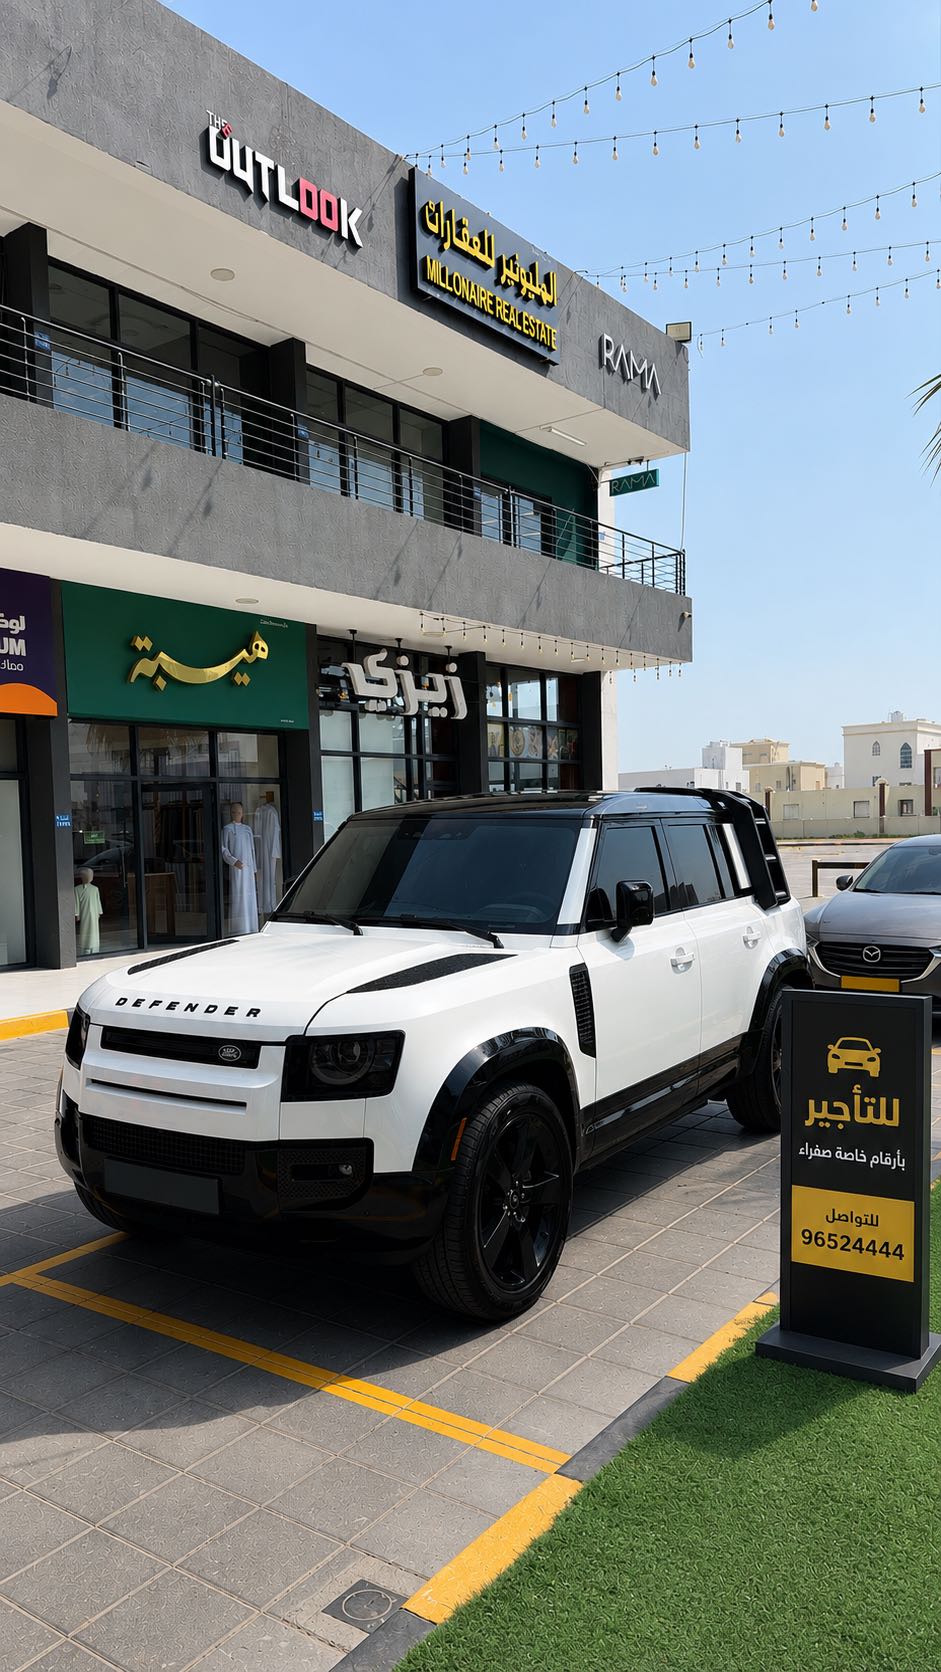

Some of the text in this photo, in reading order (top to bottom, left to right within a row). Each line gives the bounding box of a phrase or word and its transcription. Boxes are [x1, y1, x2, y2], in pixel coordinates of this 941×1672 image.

[208, 125, 363, 248] OUTLOOK
[425, 200, 495, 269] للعقارات
[426, 255, 557, 350] MILLONAIRE REAL ESTATE
[341, 648, 468, 720] زيزي
[115, 997, 262, 1018] DEFENDER
[804, 1084, 900, 1130] للتأجير
[798, 1141, 906, 1172] بأرقام خاصة صفراء
[825, 1207, 880, 1228] للتواصل
[800, 1228, 905, 1261] 96524444
